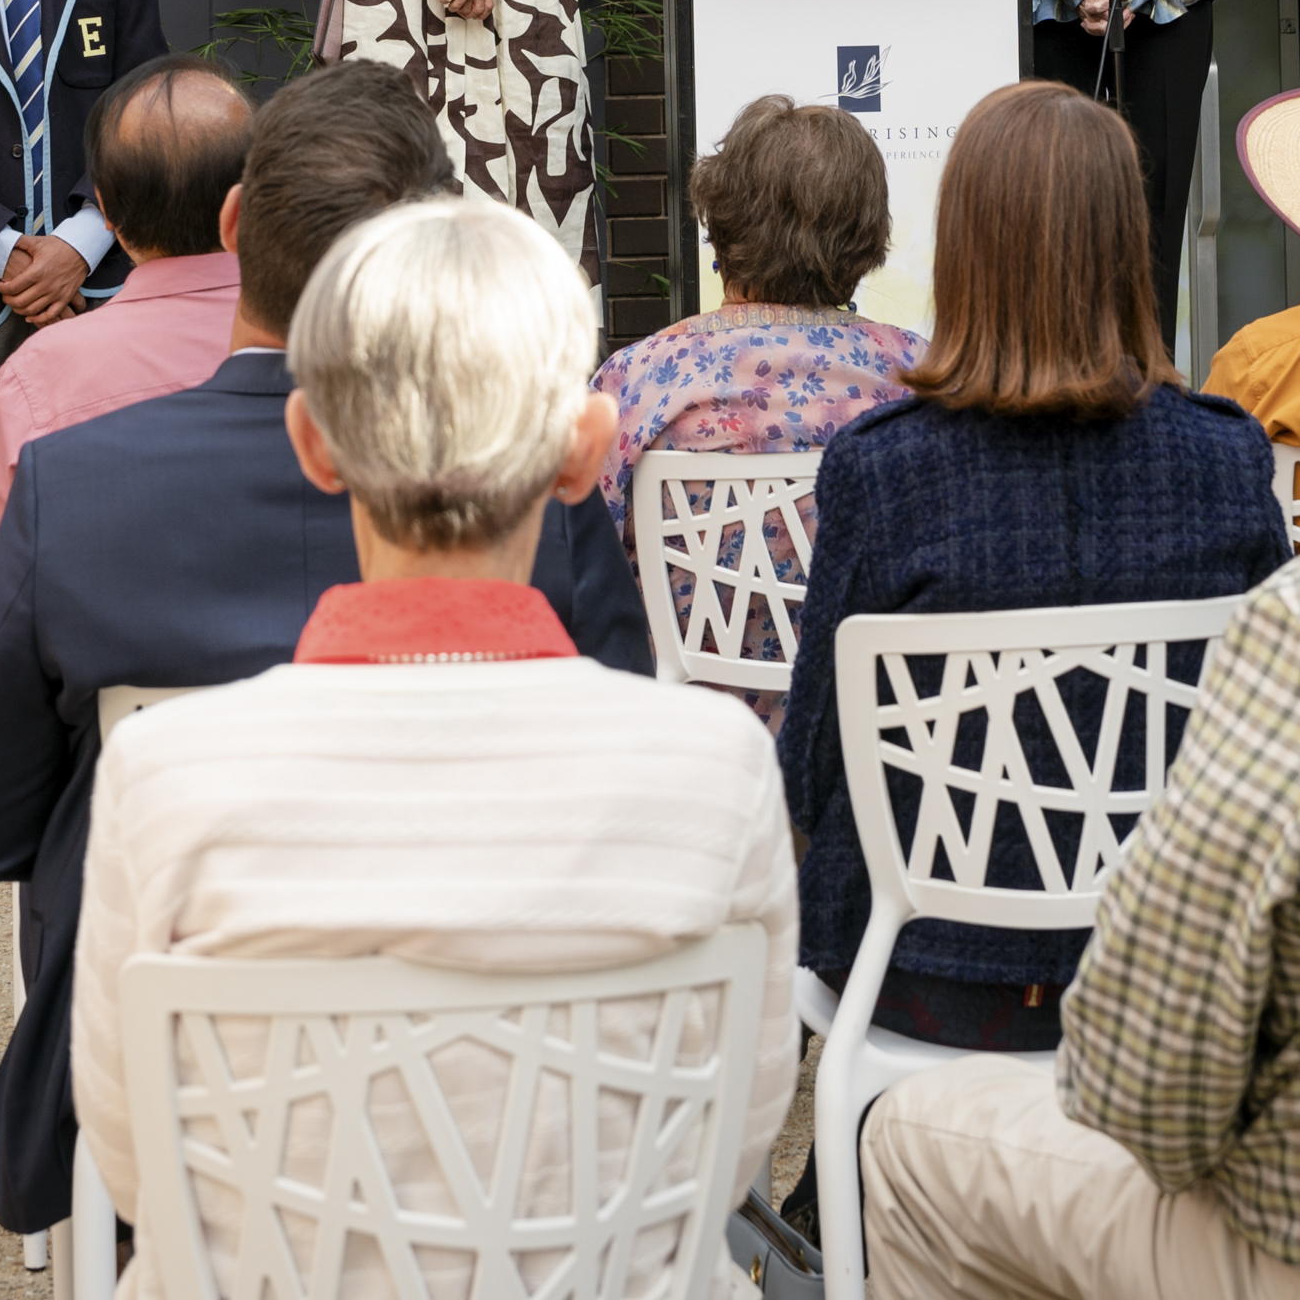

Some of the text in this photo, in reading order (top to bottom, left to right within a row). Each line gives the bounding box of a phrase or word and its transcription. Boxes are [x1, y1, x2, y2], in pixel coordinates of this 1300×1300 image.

[77, 16, 107, 58] E
[869, 126, 957, 140] RISING
[881, 150, 941, 160] PERIENCE
